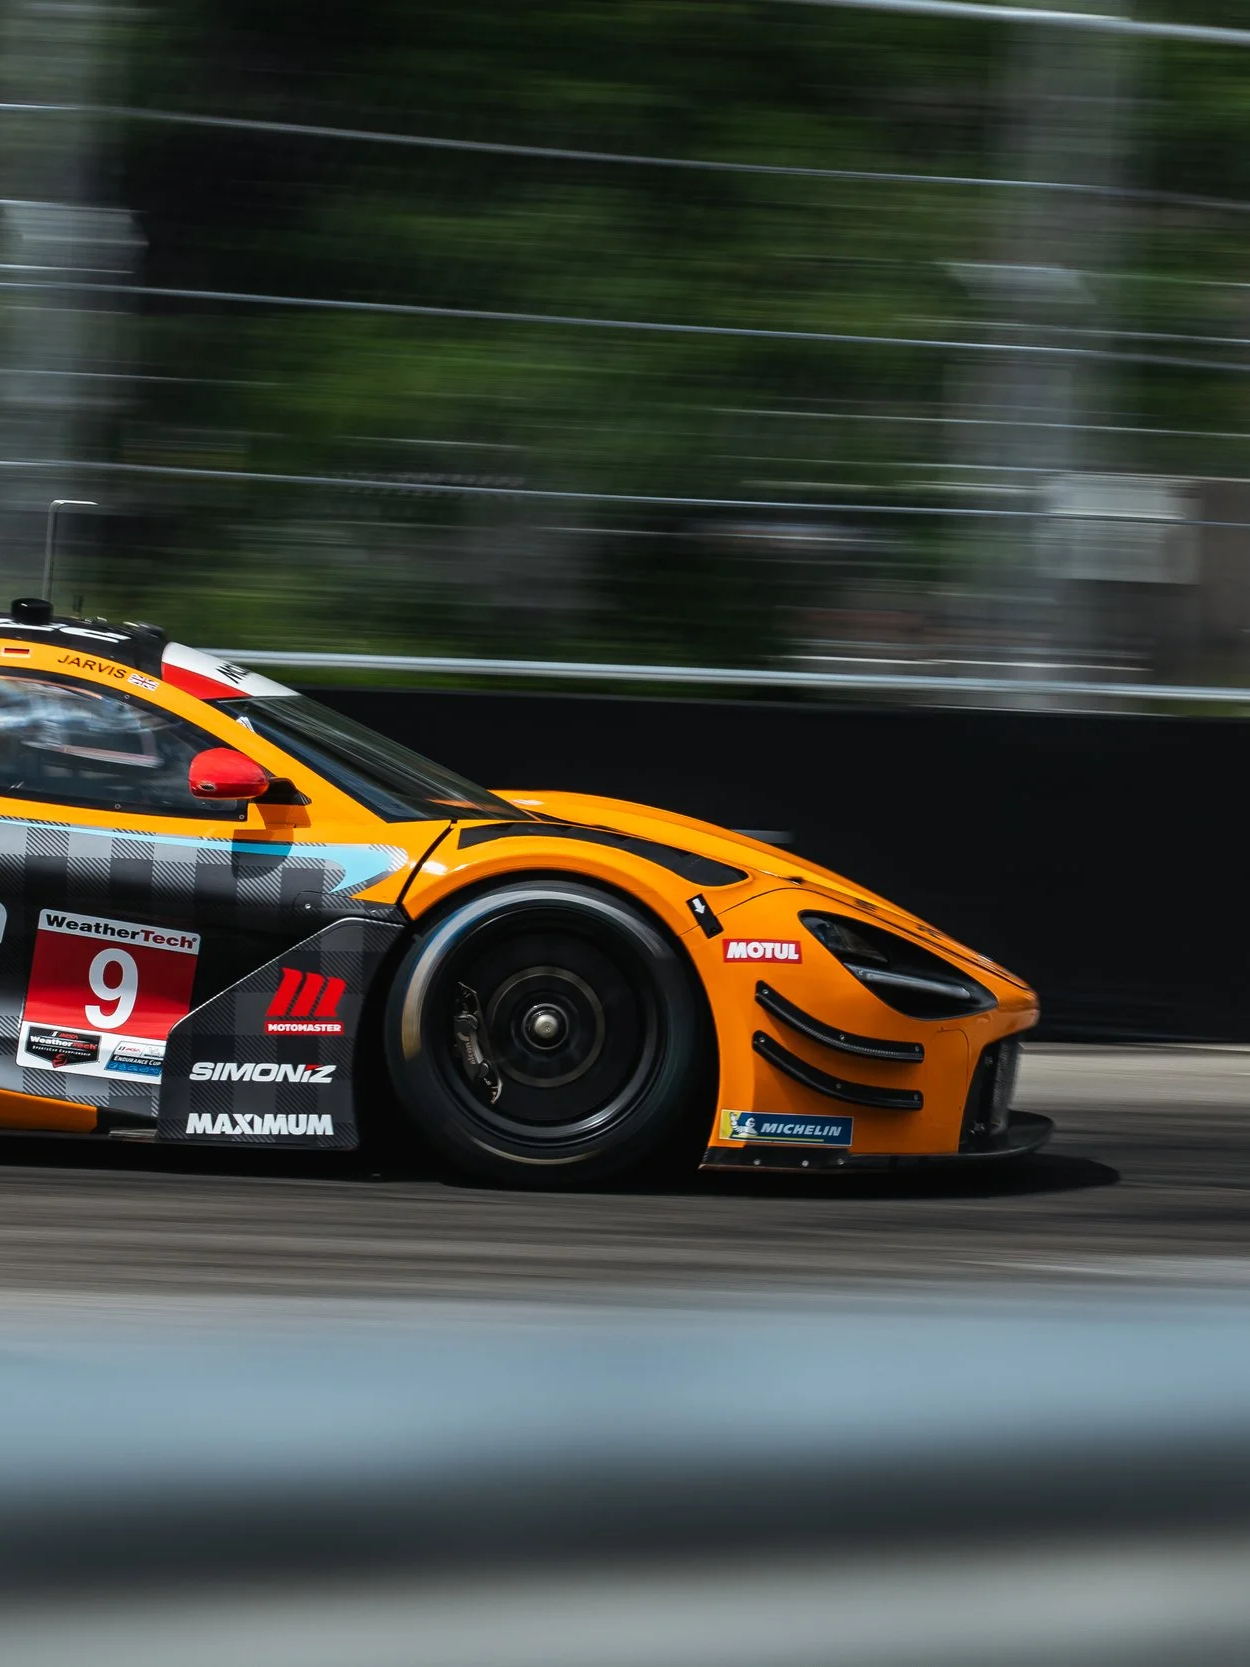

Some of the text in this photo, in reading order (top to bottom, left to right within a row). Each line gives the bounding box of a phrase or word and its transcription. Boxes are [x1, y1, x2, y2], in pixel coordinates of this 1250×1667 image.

[57, 654, 127, 679] JARVIS
[46, 913, 196, 949] WeatherTech
[726, 941, 800, 960] MOTUL
[84, 947, 139, 1030] 9
[267, 1023, 342, 1033] MOTOMASTER
[186, 1113, 334, 1136] MAXIMUM
[760, 1122, 842, 1137] MICHELIN
